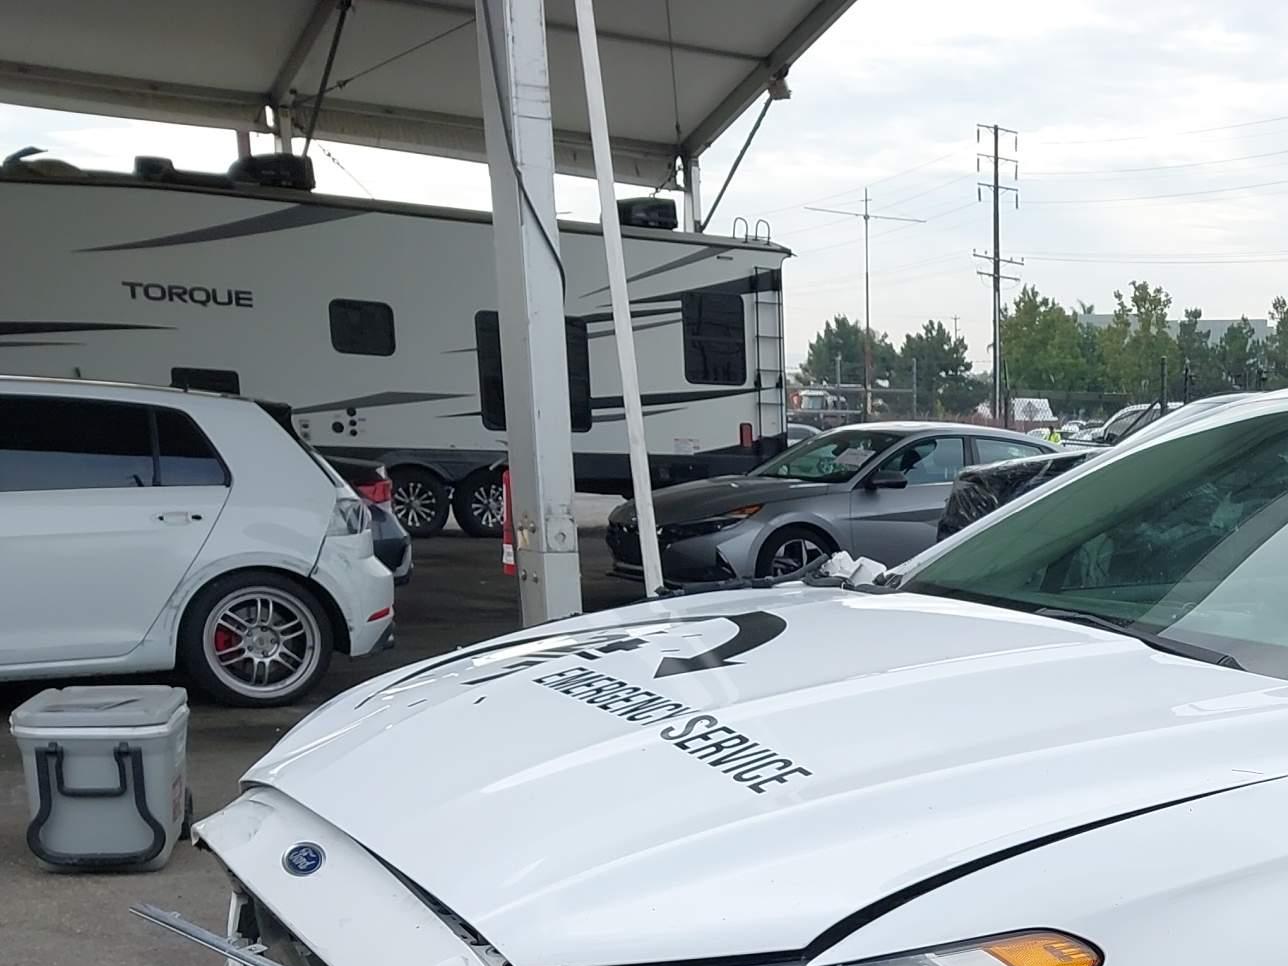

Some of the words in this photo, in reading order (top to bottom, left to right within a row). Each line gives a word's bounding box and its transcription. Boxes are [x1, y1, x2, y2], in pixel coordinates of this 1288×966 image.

[121, 281, 253, 308] TORQUE
[533, 667, 703, 726] EMERGENCY
[660, 714, 813, 794] SERVICE
